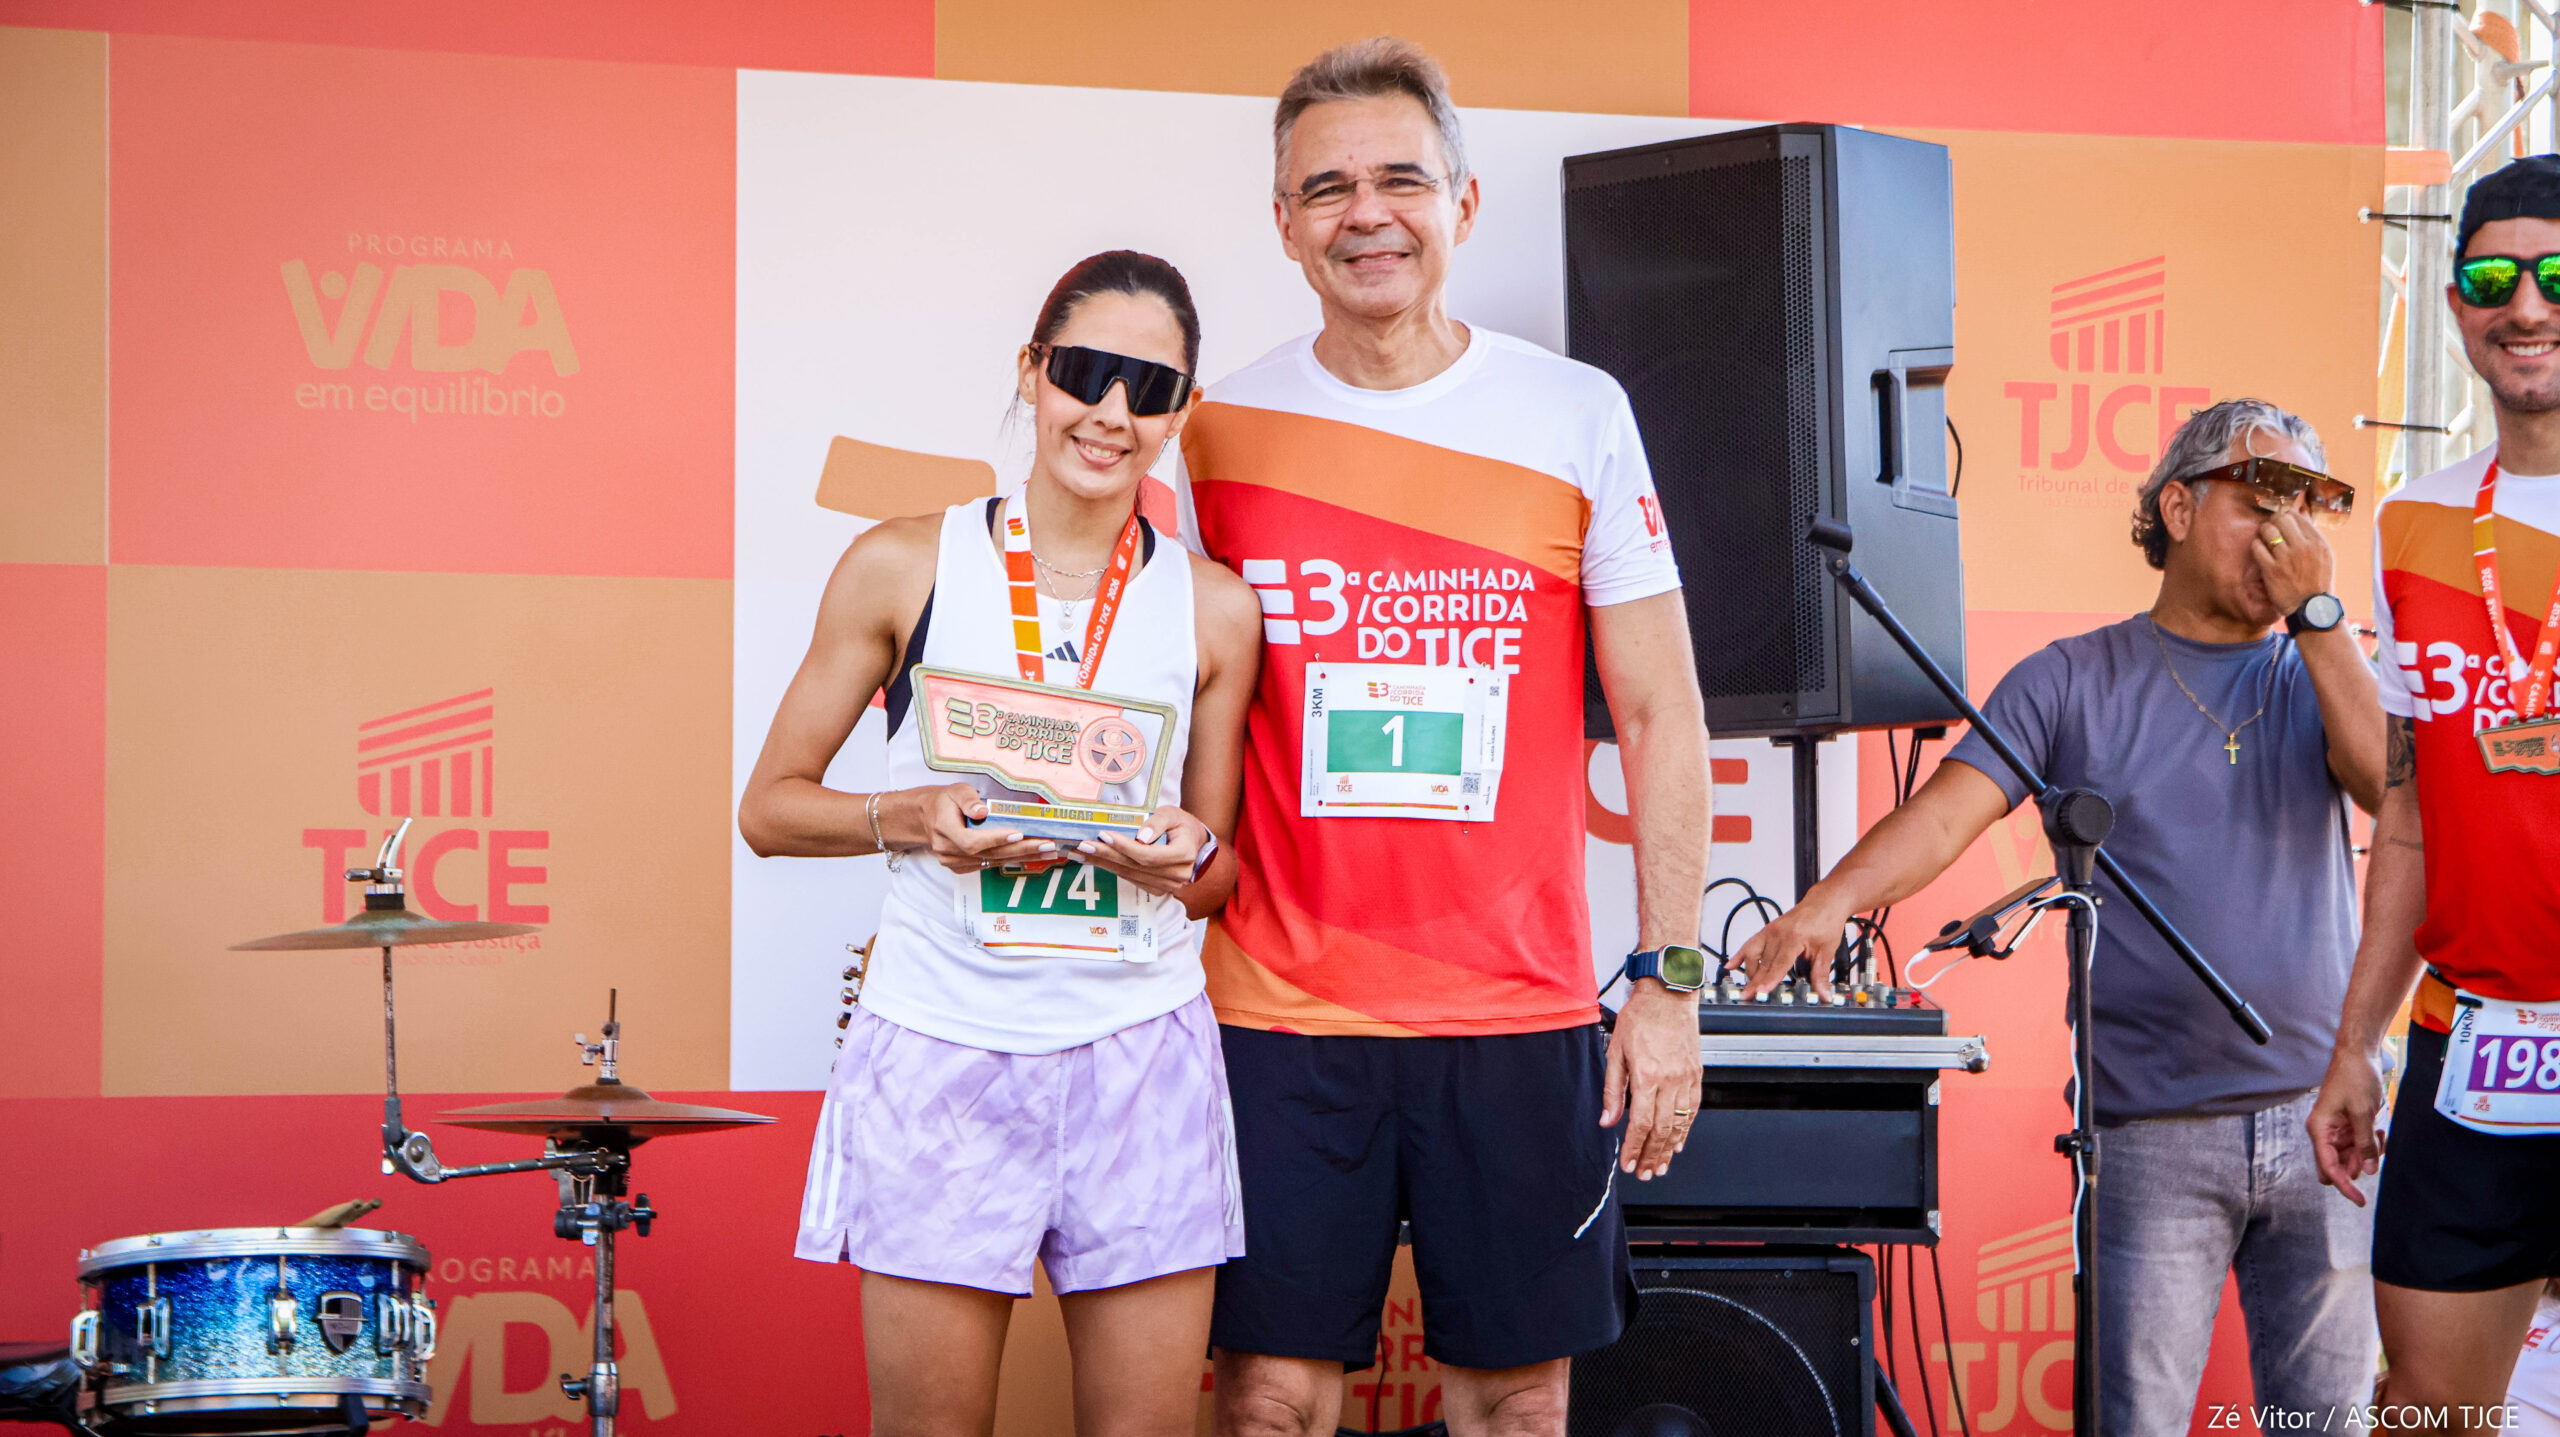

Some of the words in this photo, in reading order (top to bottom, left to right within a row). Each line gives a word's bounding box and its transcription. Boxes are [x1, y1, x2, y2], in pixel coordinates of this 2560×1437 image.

[348, 232, 514, 260] PROGRAMA
[280, 258, 581, 378] VIDA
[295, 382, 354, 410] em
[364, 376, 566, 424] equilíbrio
[2018, 474, 2098, 494] Tribunal
[2105, 475, 2129, 495] de
[1367, 568, 1535, 593] CAMINHADA
[1093, 625, 1105, 642] DO
[1099, 603, 1112, 625] TJCE
[1106, 578, 1121, 601] 2026
[1356, 593, 1528, 624] /CORRIDA
[1357, 626, 1411, 659] DO
[1416, 626, 1523, 675] TJCE
[1311, 687, 1324, 718] 3KM
[1402, 696, 1423, 706] TJCE
[998, 720, 1077, 745] /CORRIDA
[1005, 711, 1080, 732] CAMINHADA
[997, 733, 1022, 750] DO
[1023, 738, 1073, 765] TJCE
[1381, 714, 1404, 767] 1
[1336, 784, 1353, 793] TJCE
[1053, 808, 1094, 821] LUGAR
[302, 828, 550, 925] TCE
[993, 924, 1011, 933] TJCE
[2459, 1009, 2475, 1044] 10KM
[427, 1256, 596, 1283] OGRAMA
[1931, 1340, 2075, 1432] TJC
